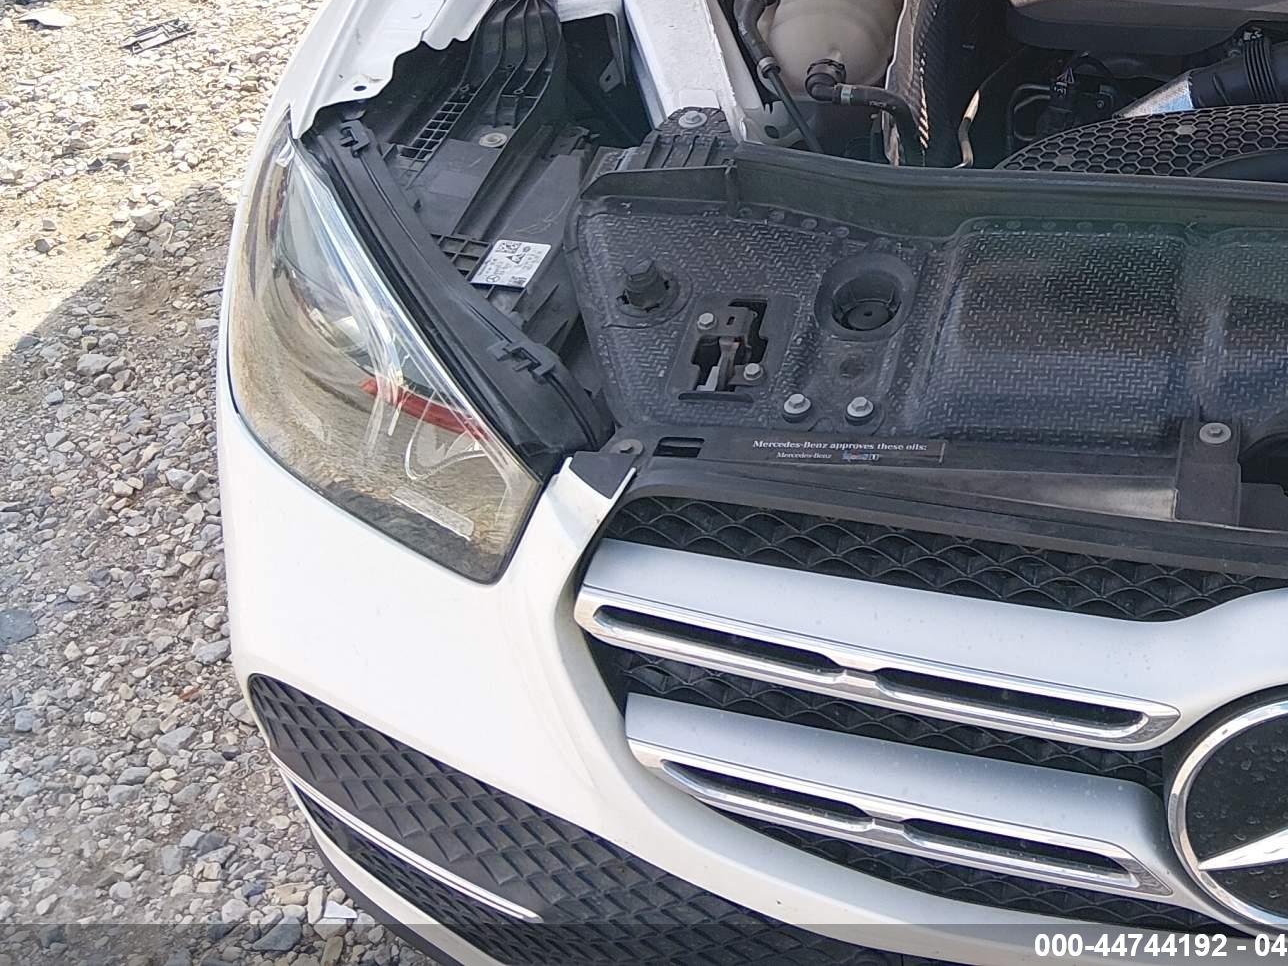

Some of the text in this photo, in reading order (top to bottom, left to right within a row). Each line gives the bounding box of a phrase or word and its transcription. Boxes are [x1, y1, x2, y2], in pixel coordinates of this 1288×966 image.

[752, 440, 828, 449] Mercedes-Benz
[830, 442, 874, 451] approves
[906, 443, 928, 451] oils:
[776, 451, 832, 459] Mercedes-Benz
